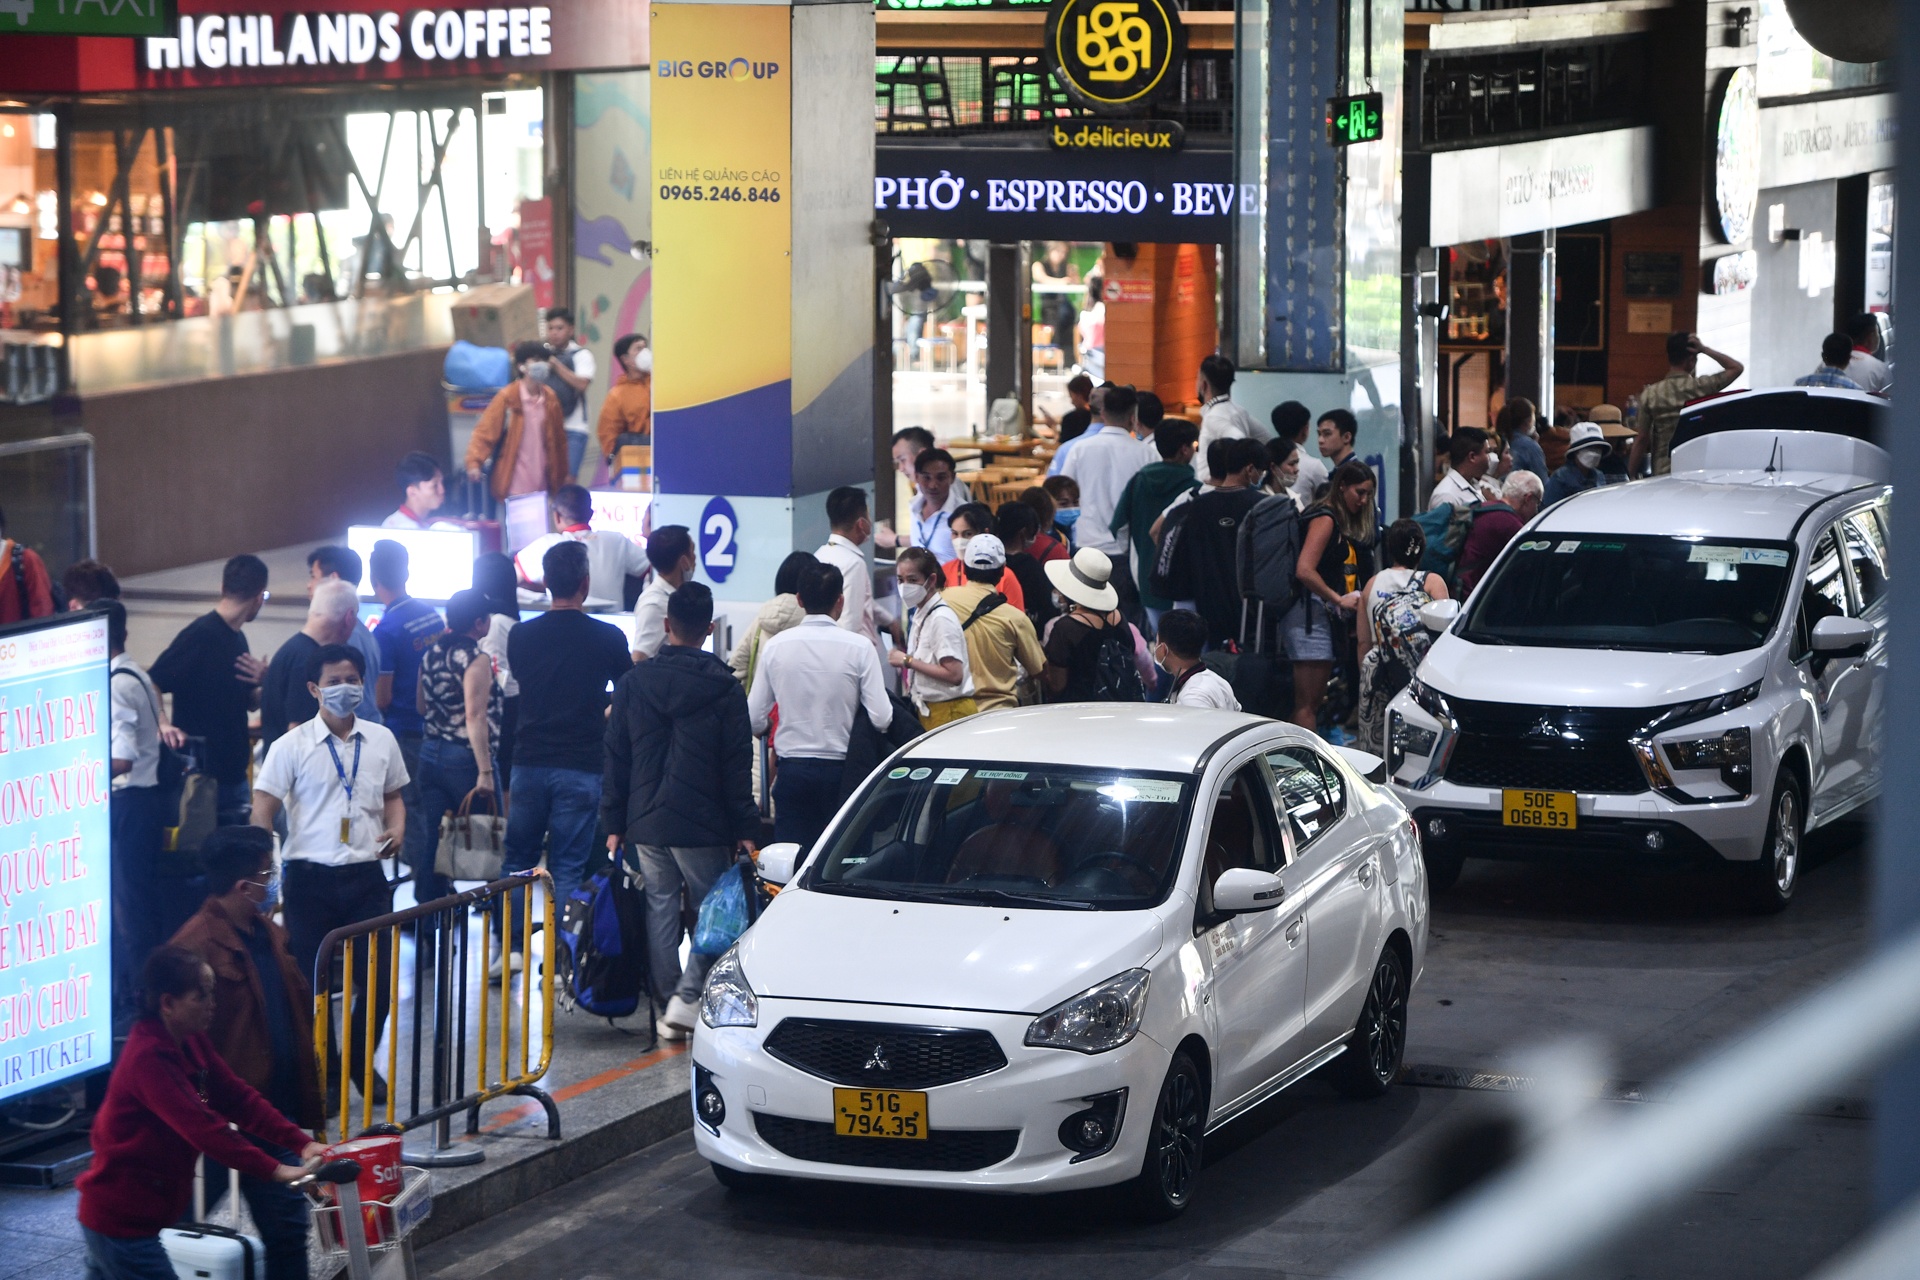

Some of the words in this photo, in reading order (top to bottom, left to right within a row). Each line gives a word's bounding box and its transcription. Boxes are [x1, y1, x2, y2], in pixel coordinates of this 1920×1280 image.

[147, 12, 402, 69] HIGHLANDS
[410, 7, 552, 60] COFFEE
[657, 60, 694, 78] BIG
[697, 57, 780, 82] GROUP
[1054, 124, 1171, 148] b.délicieux
[659, 167, 683, 180] LIÊN
[685, 168, 700, 183] HỆ
[702, 167, 749, 182] QUẢNG
[751, 169, 781, 182] CÁO
[659, 184, 781, 203] 0965.246.846
[874, 169, 966, 211] PHỞ
[986, 179, 1148, 214] ESPRESSO
[704, 513, 734, 567] 2
[14, 690, 59, 751] MÁY
[62, 691, 100, 742] BAY
[0, 774, 44, 827] ONG
[1524, 792, 1555, 809] 50E
[1511, 809, 1568, 827] 068.93
[16, 903, 61, 965] MÁY
[65, 901, 102, 952] BAY
[28, 1031, 95, 1078] TICKET
[860, 1092, 900, 1113] 51G
[844, 1113, 918, 1137] 794.35
